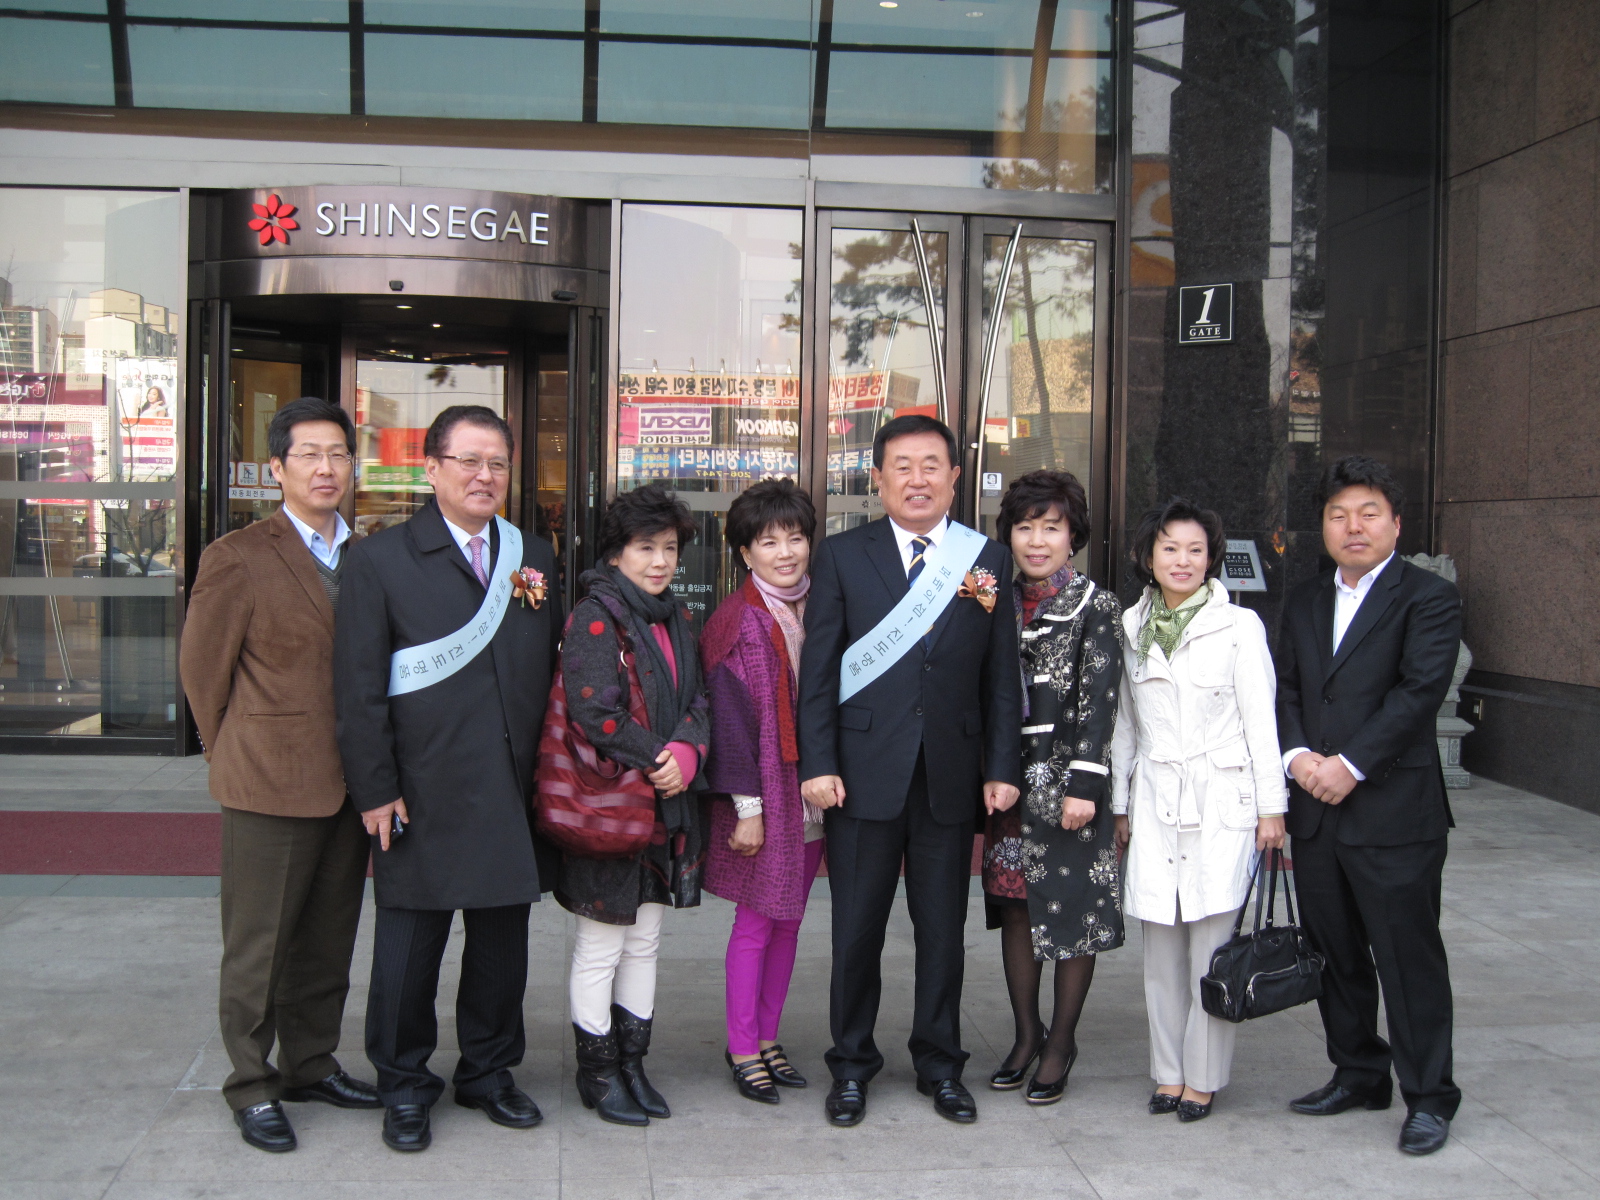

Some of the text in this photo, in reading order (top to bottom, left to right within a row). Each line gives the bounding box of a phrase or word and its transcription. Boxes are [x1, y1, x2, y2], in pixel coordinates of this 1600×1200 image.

[316, 202, 549, 245] SHINSEGAE
[1195, 287, 1215, 324] 1
[1189, 327, 1221, 336] GATE
[231, 489, 266, 498] 자동회전문
[687, 583, 713, 593] 출입금지
[687, 601, 706, 610] 반가능
